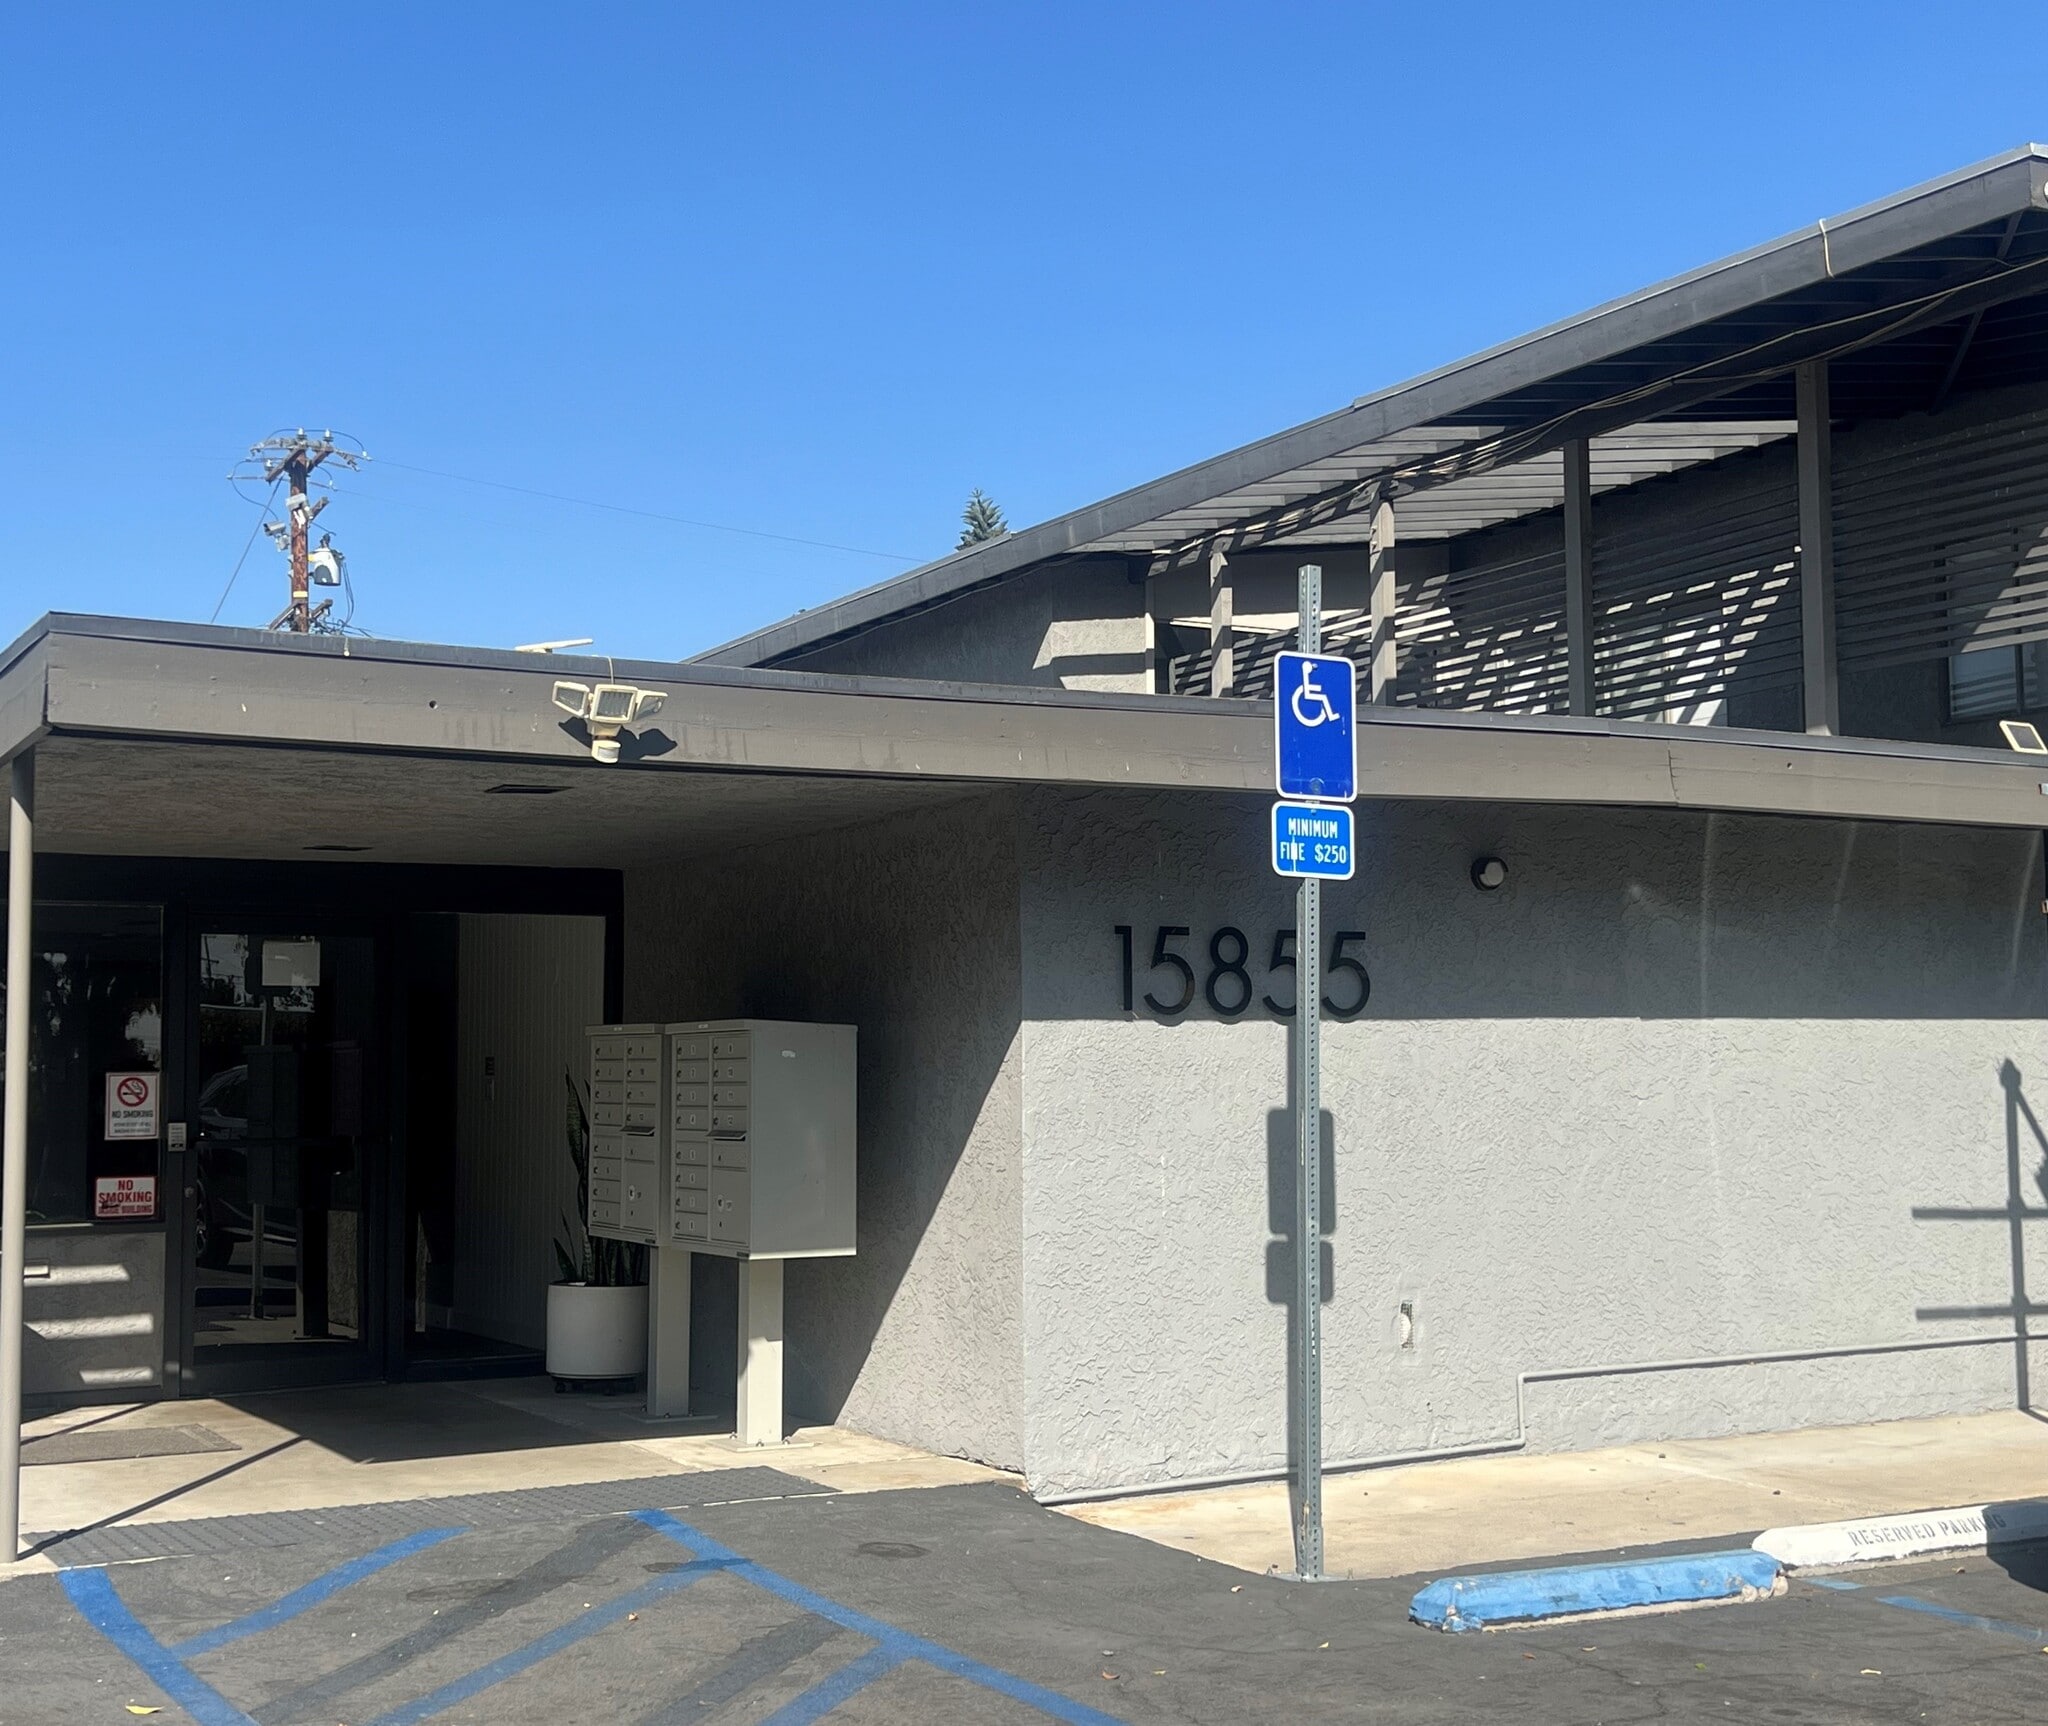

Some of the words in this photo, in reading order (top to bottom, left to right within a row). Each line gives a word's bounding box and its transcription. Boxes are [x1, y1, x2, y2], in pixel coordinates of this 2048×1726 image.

[1288, 817, 1338, 839] MINIMUM
[1314, 844, 1347, 864] $250
[1114, 925, 1371, 1017] 15855
[111, 1110, 121, 1118] NO
[123, 1110, 154, 1118] SMOKING
[118, 1179, 134, 1191] NO
[98, 1191, 152, 1203] SMOKING
[1847, 1522, 1936, 1547] RESERVED
[1937, 1513, 2008, 1537] PARKING
